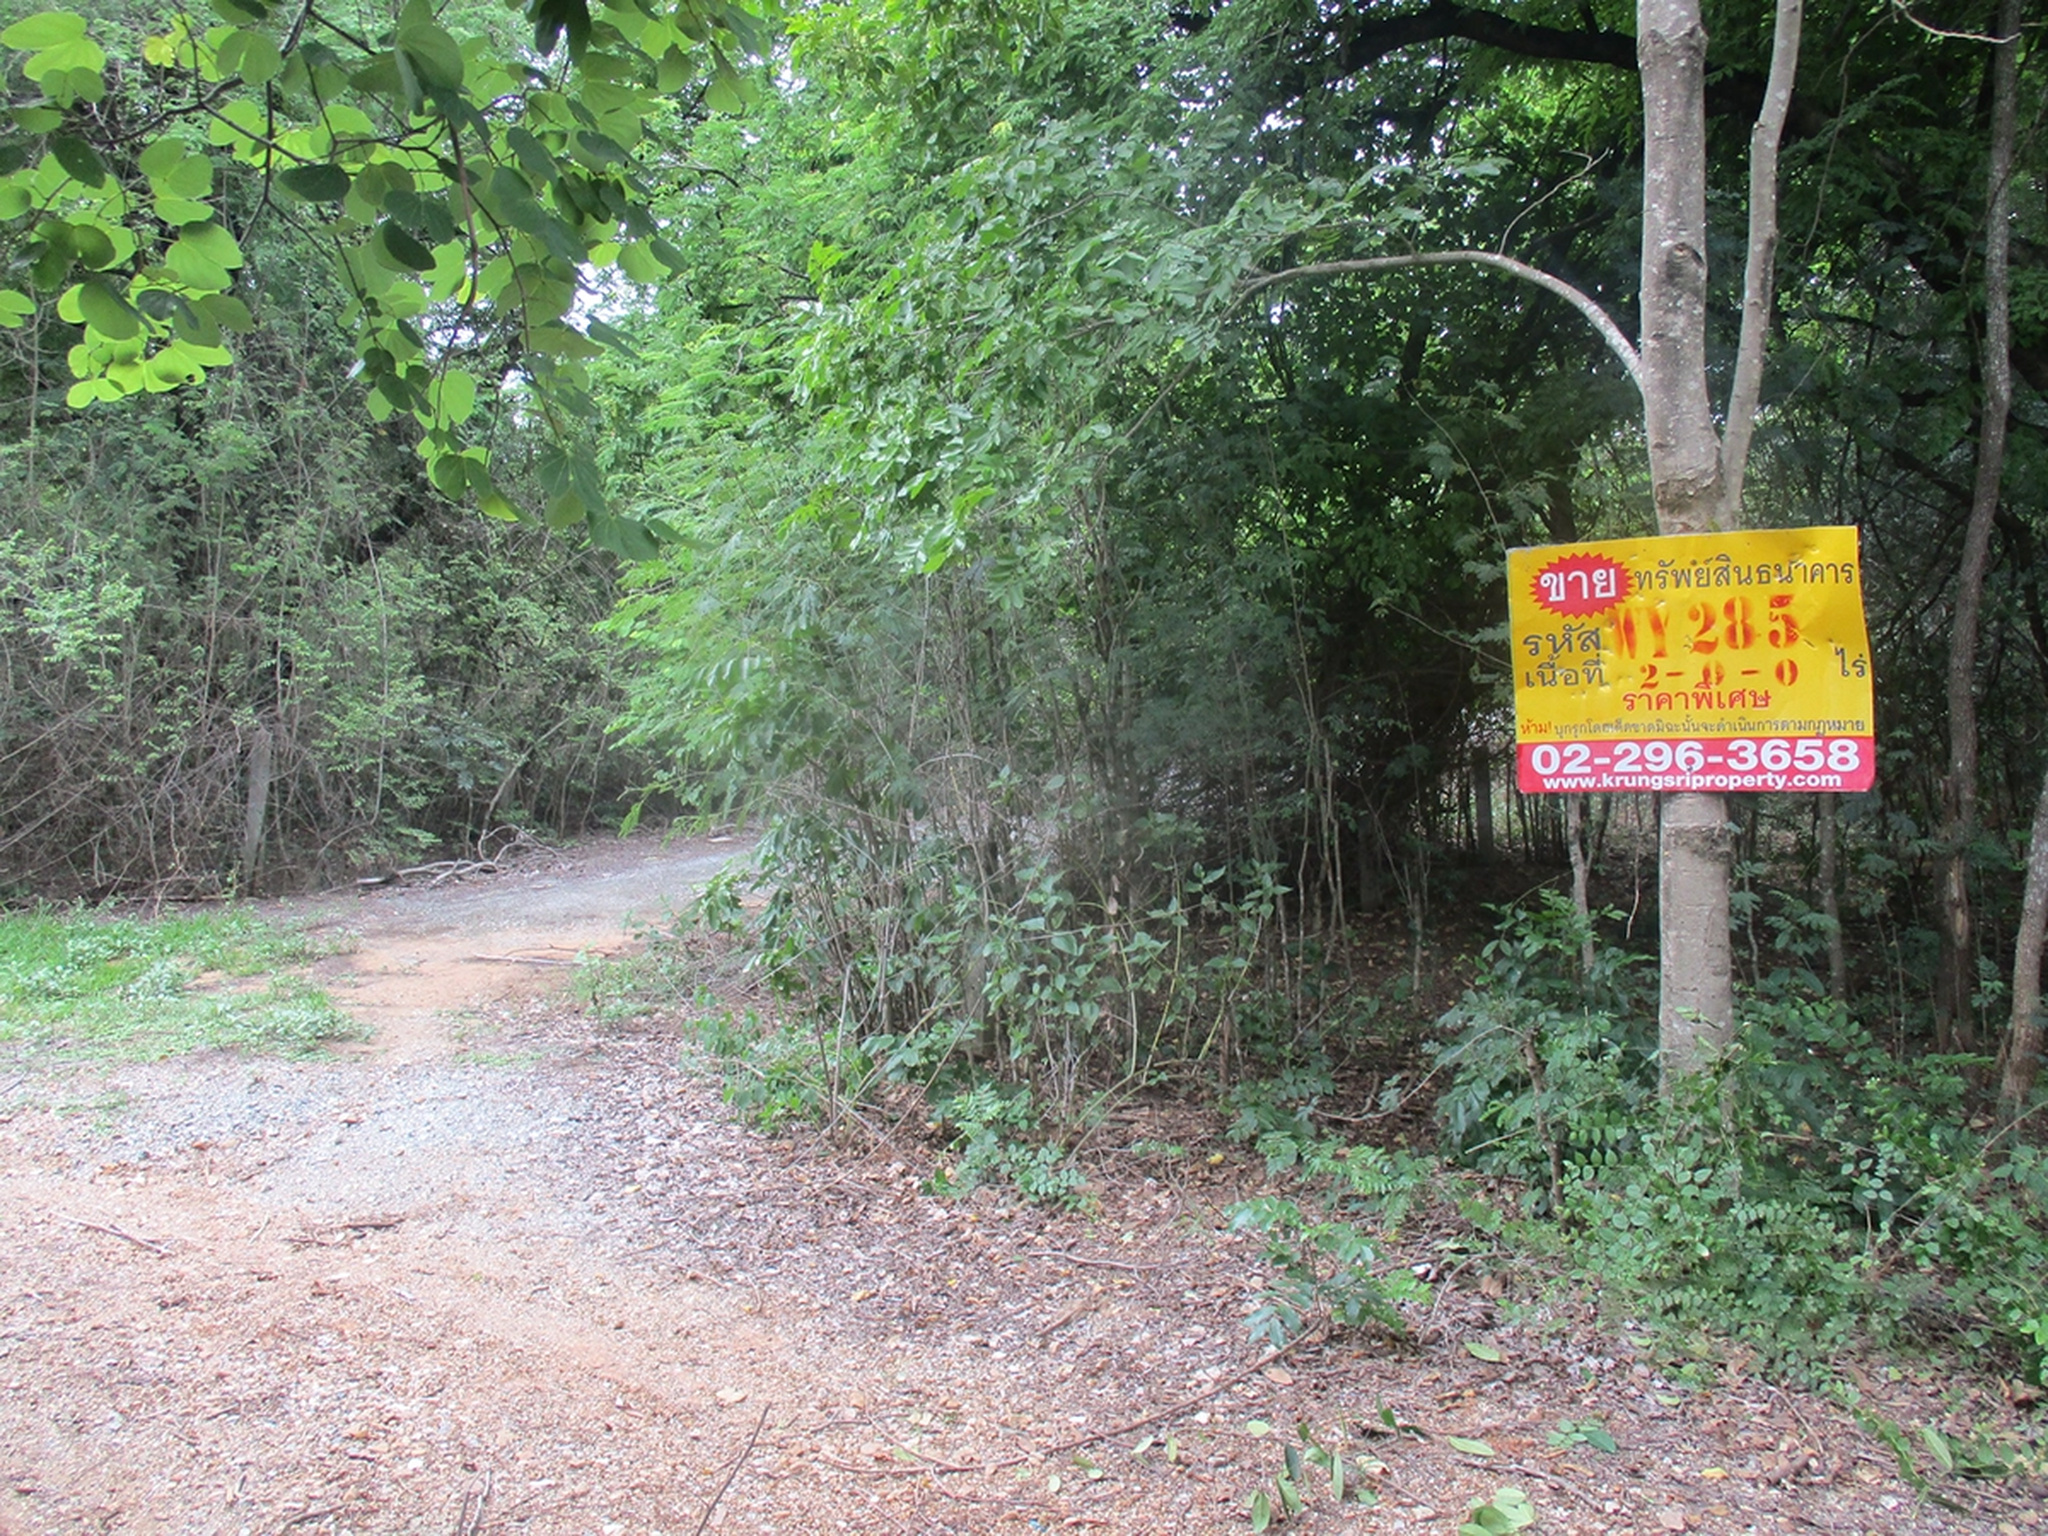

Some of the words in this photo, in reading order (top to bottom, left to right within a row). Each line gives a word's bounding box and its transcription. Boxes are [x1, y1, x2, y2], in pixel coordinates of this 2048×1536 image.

[1540, 567, 1617, 602] ขาย
[1634, 554, 1855, 590] ทรัพย์สินธนาคาร
[1523, 622, 1601, 656] รหัส
[1687, 593, 1800, 655] 285
[1834, 646, 1868, 677] ไร่
[1622, 681, 1772, 711] ราคาพิเศษ
[1531, 738, 1860, 775] 02-296-3658
[1542, 770, 1842, 791] www.krungsriproperty.com
